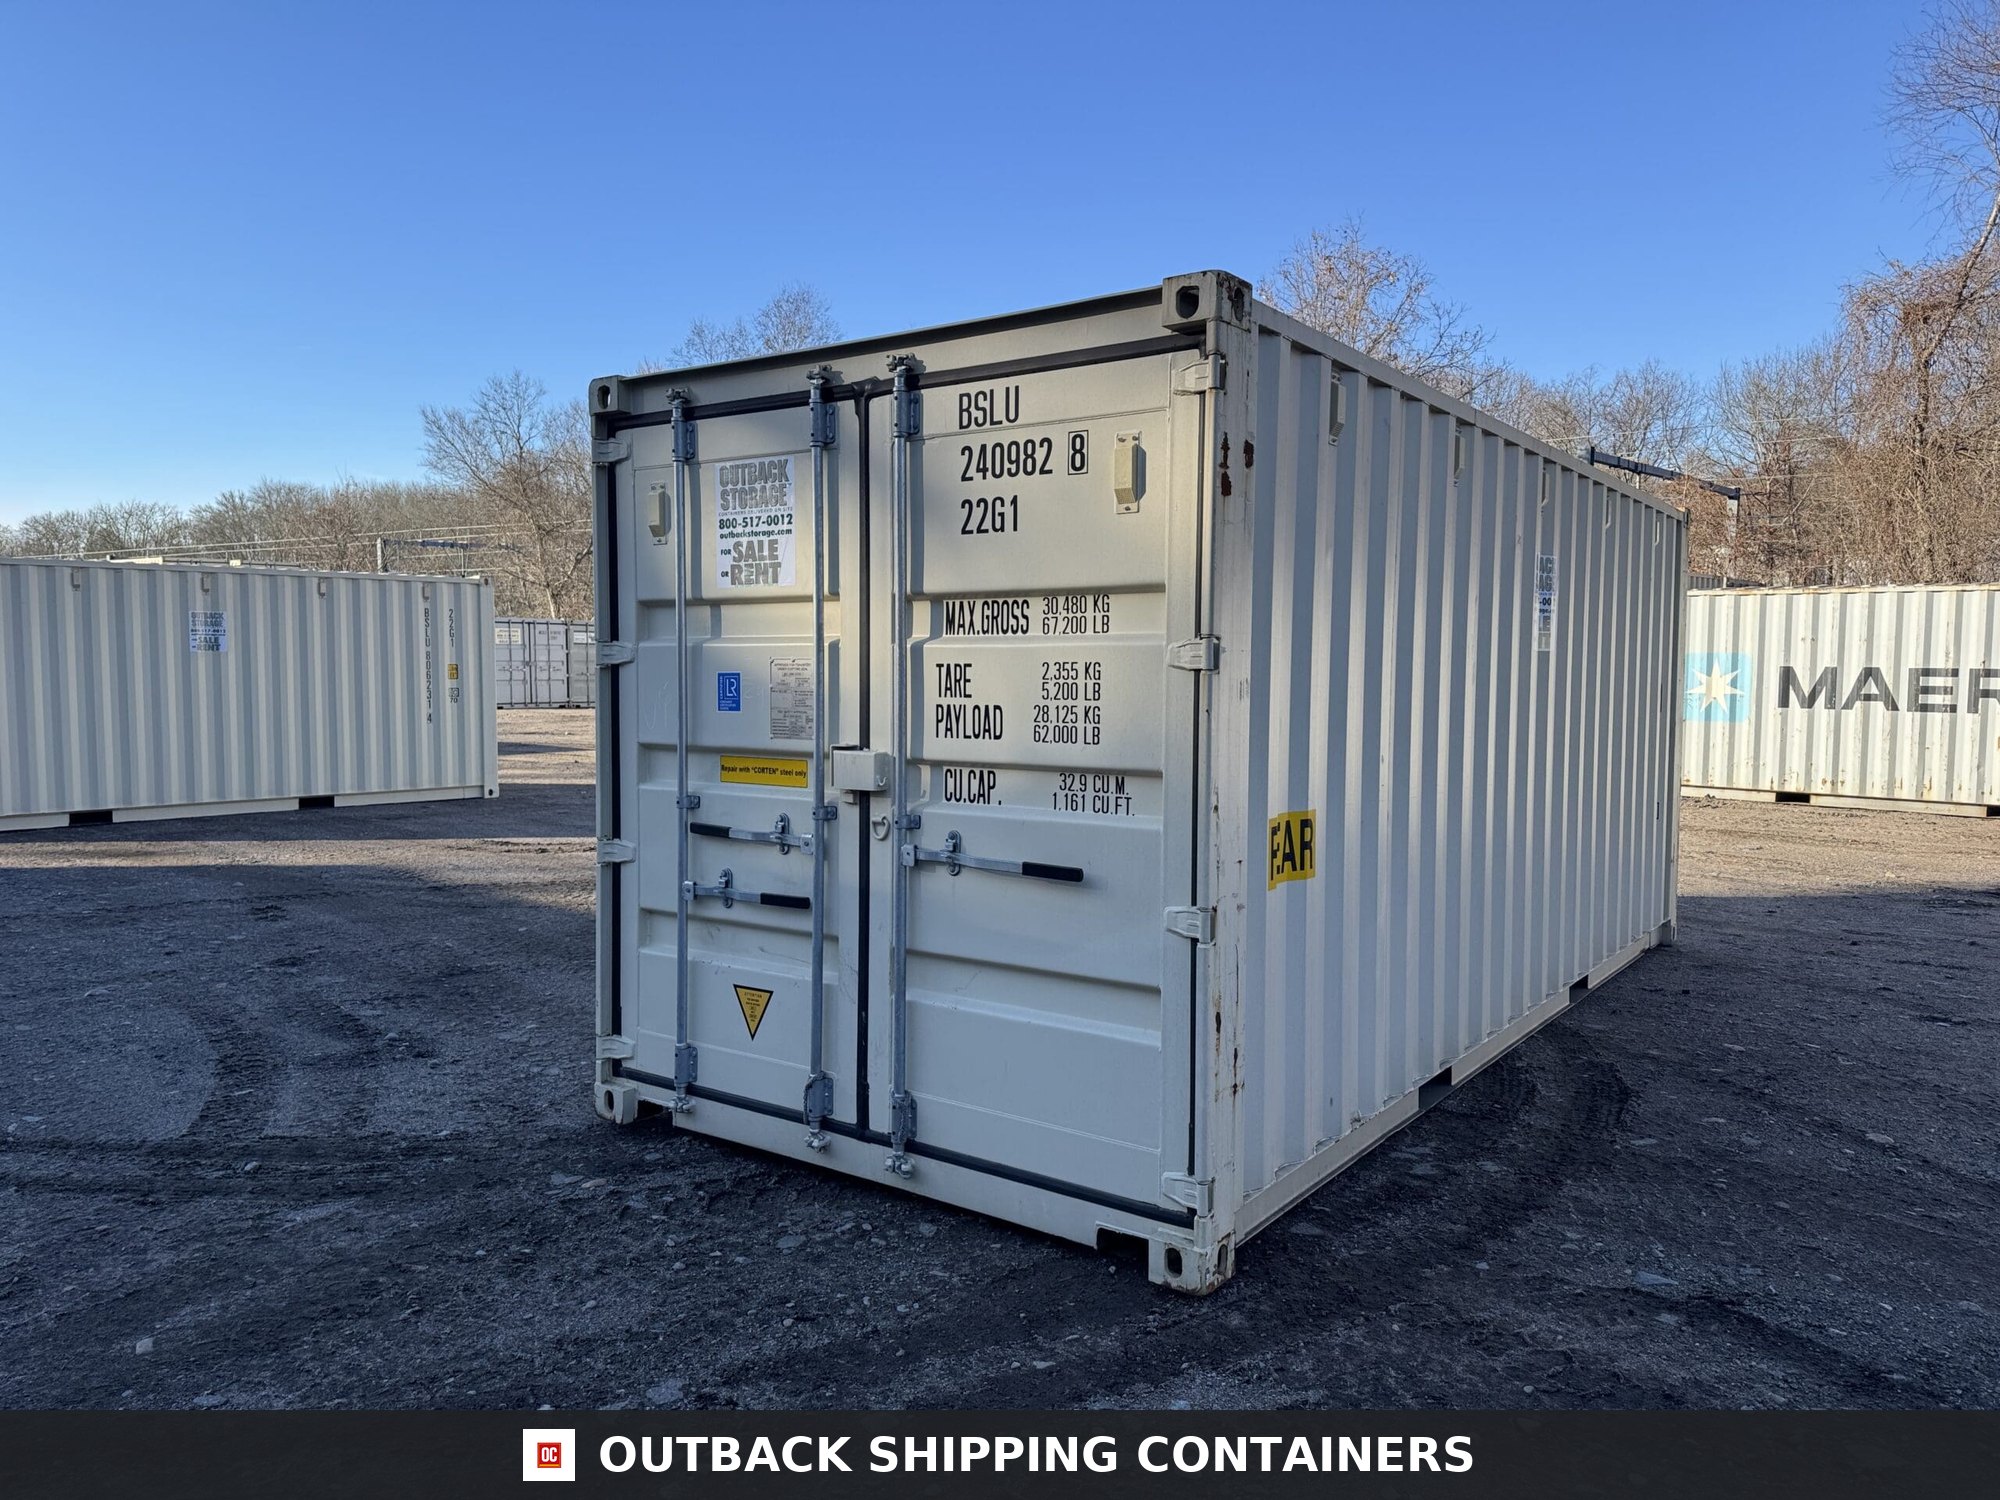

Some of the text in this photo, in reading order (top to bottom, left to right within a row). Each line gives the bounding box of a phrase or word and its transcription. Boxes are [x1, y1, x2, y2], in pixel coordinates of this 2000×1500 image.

[959, 385, 1020, 429] BSLU
[960, 433, 1086, 482] 240982 8
[719, 459, 790, 488] OUTBACK
[720, 483, 787, 511] STORAGE
[718, 513, 793, 530] 800-517-0012
[960, 495, 1019, 535] 22G1
[719, 528, 793, 540] outbackstorage.com
[720, 538, 779, 563] FOR SALE
[730, 562, 781, 586] RENT
[945, 594, 1110, 635] MAX.GROSS 30,480 KG
[1042, 615, 1110, 635] 67,200 LB
[936, 661, 1102, 698] TARE 2,355 KG
[1041, 682, 1101, 701] 5,200 LB
[936, 704, 1003, 740] PAYLOAD
[1084, 705, 1101, 724] KG
[1033, 724, 1100, 745] 62,000 LB
[721, 764, 737, 773] Repair
[780, 768, 793, 776] steel
[795, 769, 806, 778] only
[1059, 772, 1087, 792] 32.9
[1093, 774, 1129, 795] CU.M.
[1052, 792, 1135, 816] 1,161 CU.FT.
